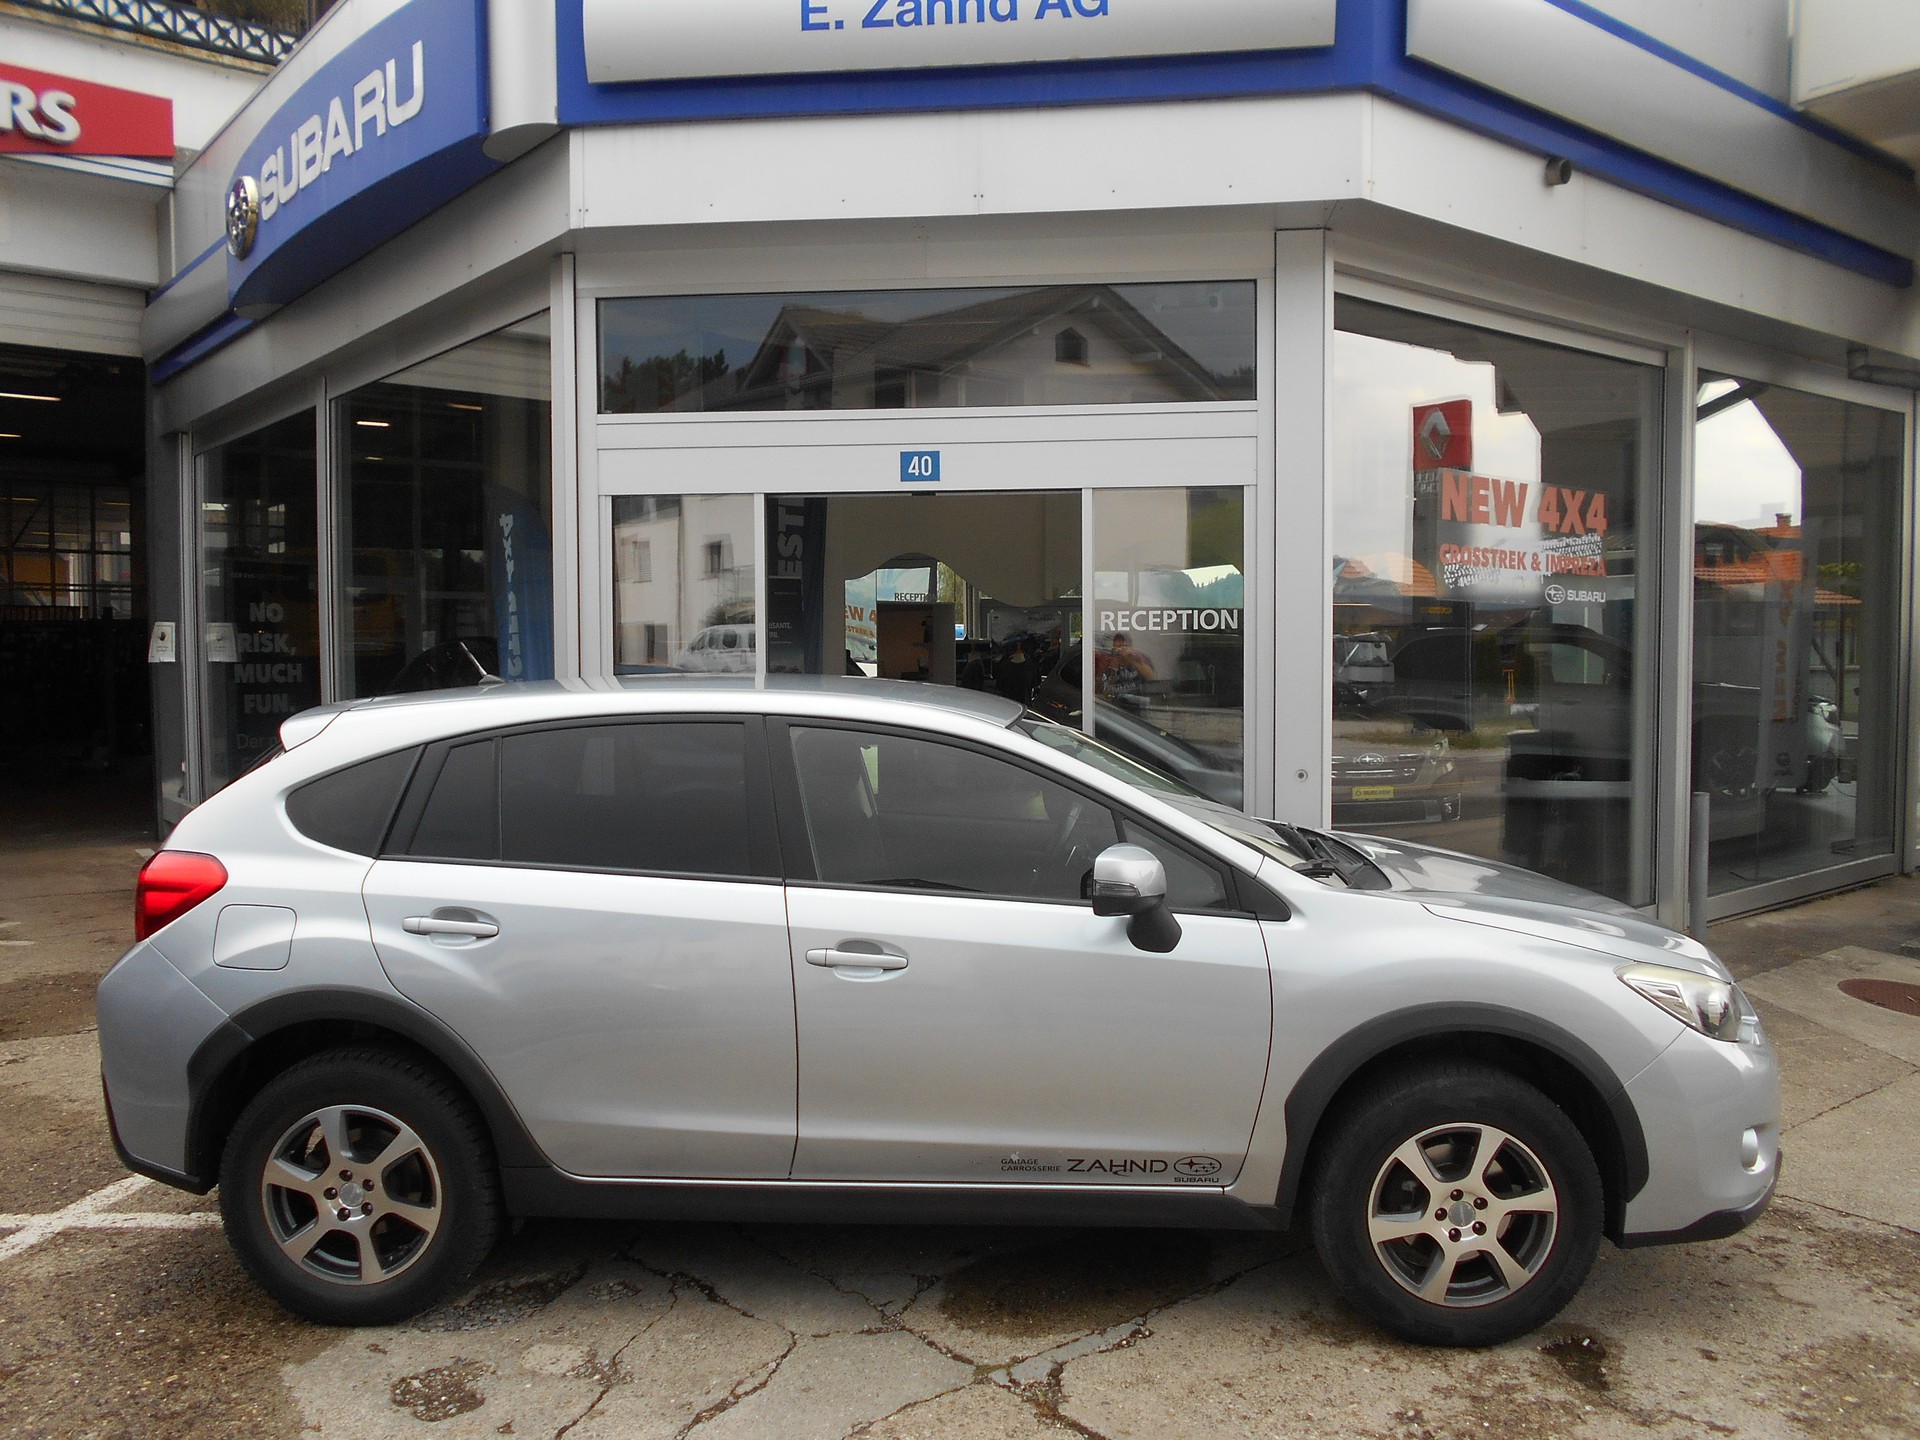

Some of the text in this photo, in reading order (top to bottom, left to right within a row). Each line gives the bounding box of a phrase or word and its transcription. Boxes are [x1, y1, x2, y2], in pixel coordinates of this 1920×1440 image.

[801, 0, 844, 31] E.
[260, 39, 425, 221] SUBARU
[907, 455, 934, 478] 40
[1441, 471, 1529, 529] NEW
[1537, 486, 1609, 537] 4X4
[1439, 543, 1607, 577] CROSSTREK & IMPREZA
[1567, 589, 1607, 603] SUBARU
[249, 602, 284, 623] NO
[1100, 609, 1239, 631] RECEPTION
[237, 632, 297, 656] RISK,
[234, 663, 303, 684] MUCH
[1067, 1159, 1168, 1175] ZAHND
